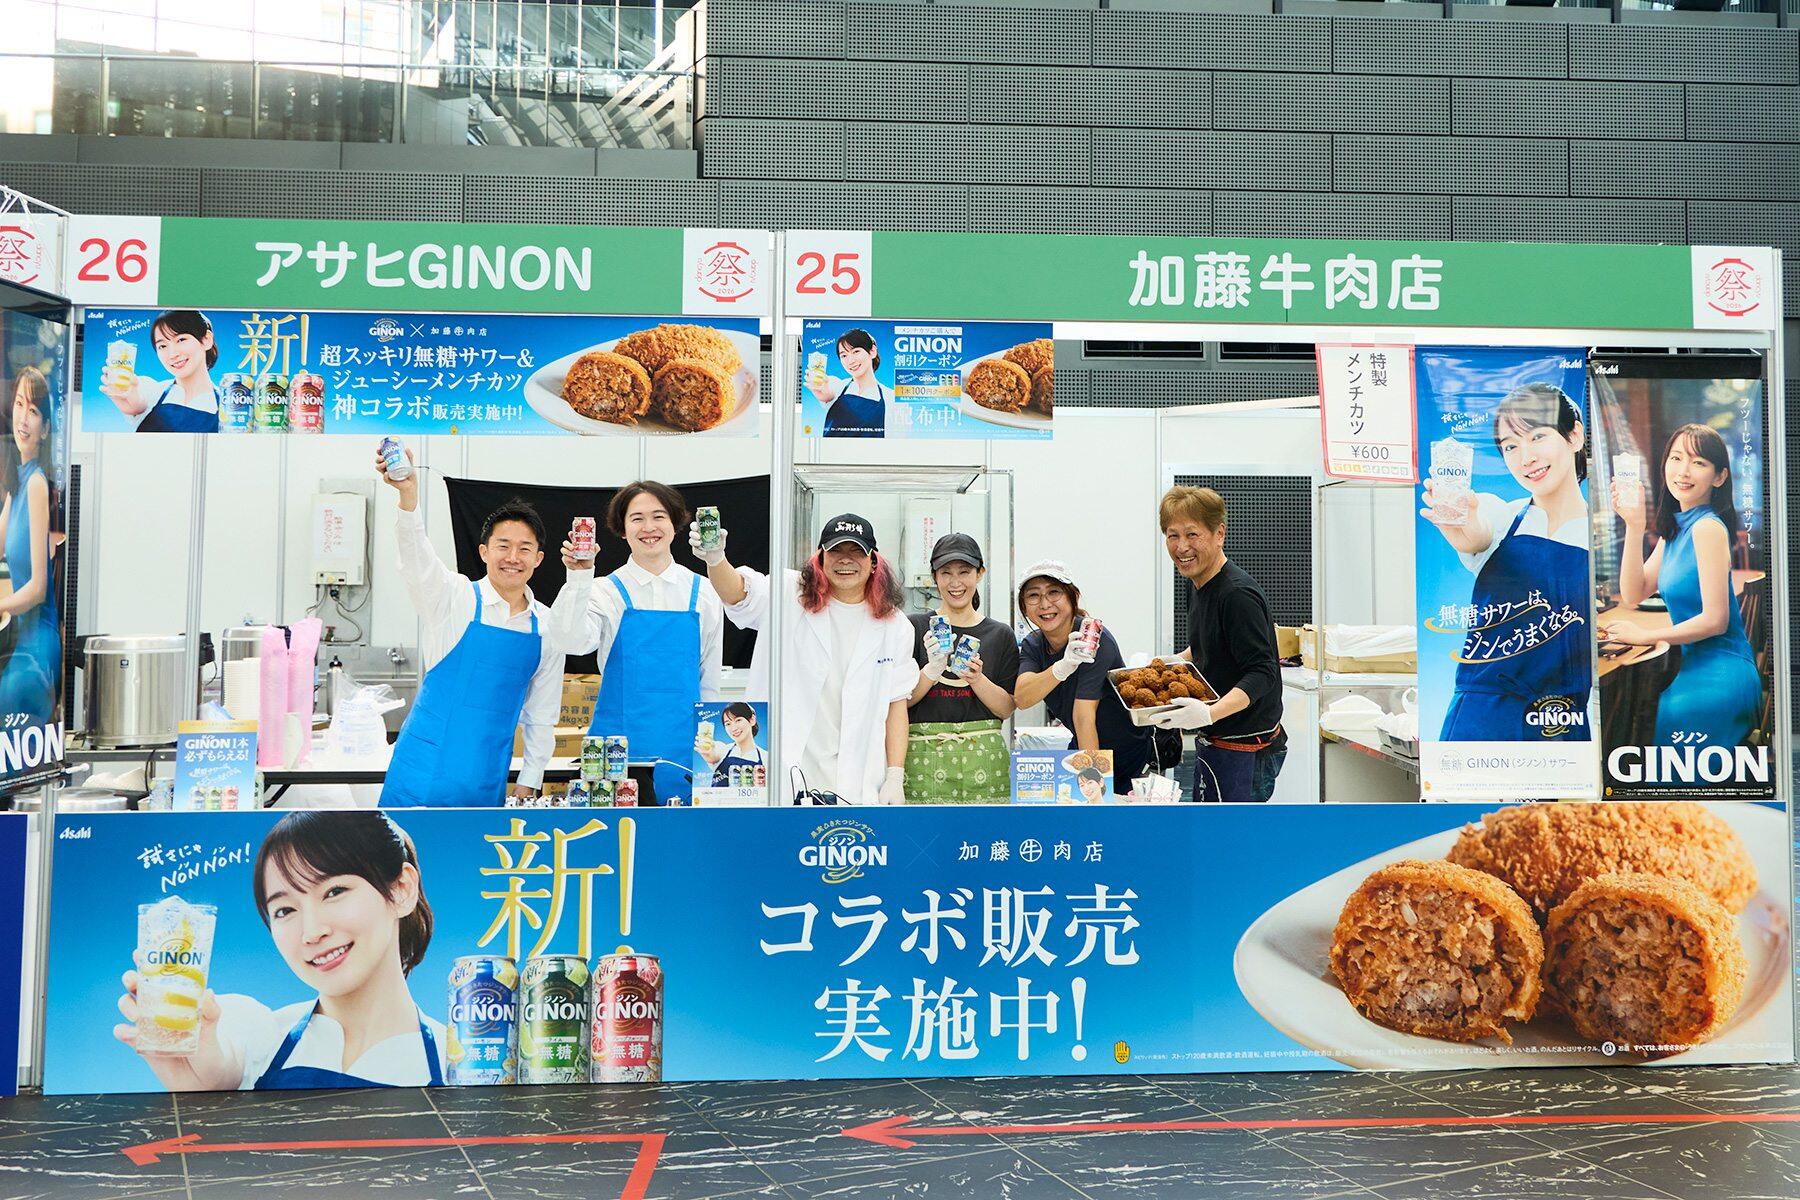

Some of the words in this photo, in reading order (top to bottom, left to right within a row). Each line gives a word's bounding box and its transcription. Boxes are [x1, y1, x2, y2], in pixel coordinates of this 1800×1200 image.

[78, 238, 148, 283] 26
[255, 241, 592, 291] アサヒGINON
[706, 251, 747, 286] 祭
[796, 252, 860, 295] 25
[1128, 250, 1443, 311] 加藤牛肉店
[1714, 267, 1752, 301] 祭
[369, 327, 404, 337] GINON
[894, 337, 963, 354] GINON
[320, 345, 534, 369] 超スッキリ無糖サワー&
[894, 354, 963, 368] 割引クーポン
[1559, 360, 1583, 370] Asahi
[1369, 352, 1388, 387] 特製
[1595, 365, 1619, 375] Asahi
[333, 370, 523, 392] ジューシーメンチカツ
[1347, 353, 1365, 435] メンチカツ
[1351, 445, 1390, 460] ¥600
[1436, 467, 1468, 477] GINON
[4, 713, 30, 729] ジノン
[1525, 711, 1584, 726] GINON
[1671, 731, 1708, 744] ジノン
[185, 750, 249, 762] 必ずもらえる!
[1608, 745, 1769, 783] GINON
[1016, 763, 1055, 773] GINON
[59, 826, 92, 840] Asahi
[828, 836, 856, 847] ジノン
[798, 845, 888, 867] GINON
[958, 838, 1104, 864] 加藤牛肉店
[476, 817, 637, 963] 新!
[759, 883, 1141, 968] コラボ販売
[147, 951, 203, 966] GINON
[472, 995, 495, 1004] ジノン
[544, 995, 567, 1003] ジノン
[616, 994, 639, 1002] ジノン
[452, 1003, 516, 1022] GINON
[524, 1002, 588, 1022] GINON
[596, 1001, 660, 1020] GINON
[814, 976, 1087, 1062] 実施中!
[467, 1045, 500, 1062] 無糖
[538, 1044, 573, 1061] 無糖
[610, 1043, 645, 1059] 無糖
